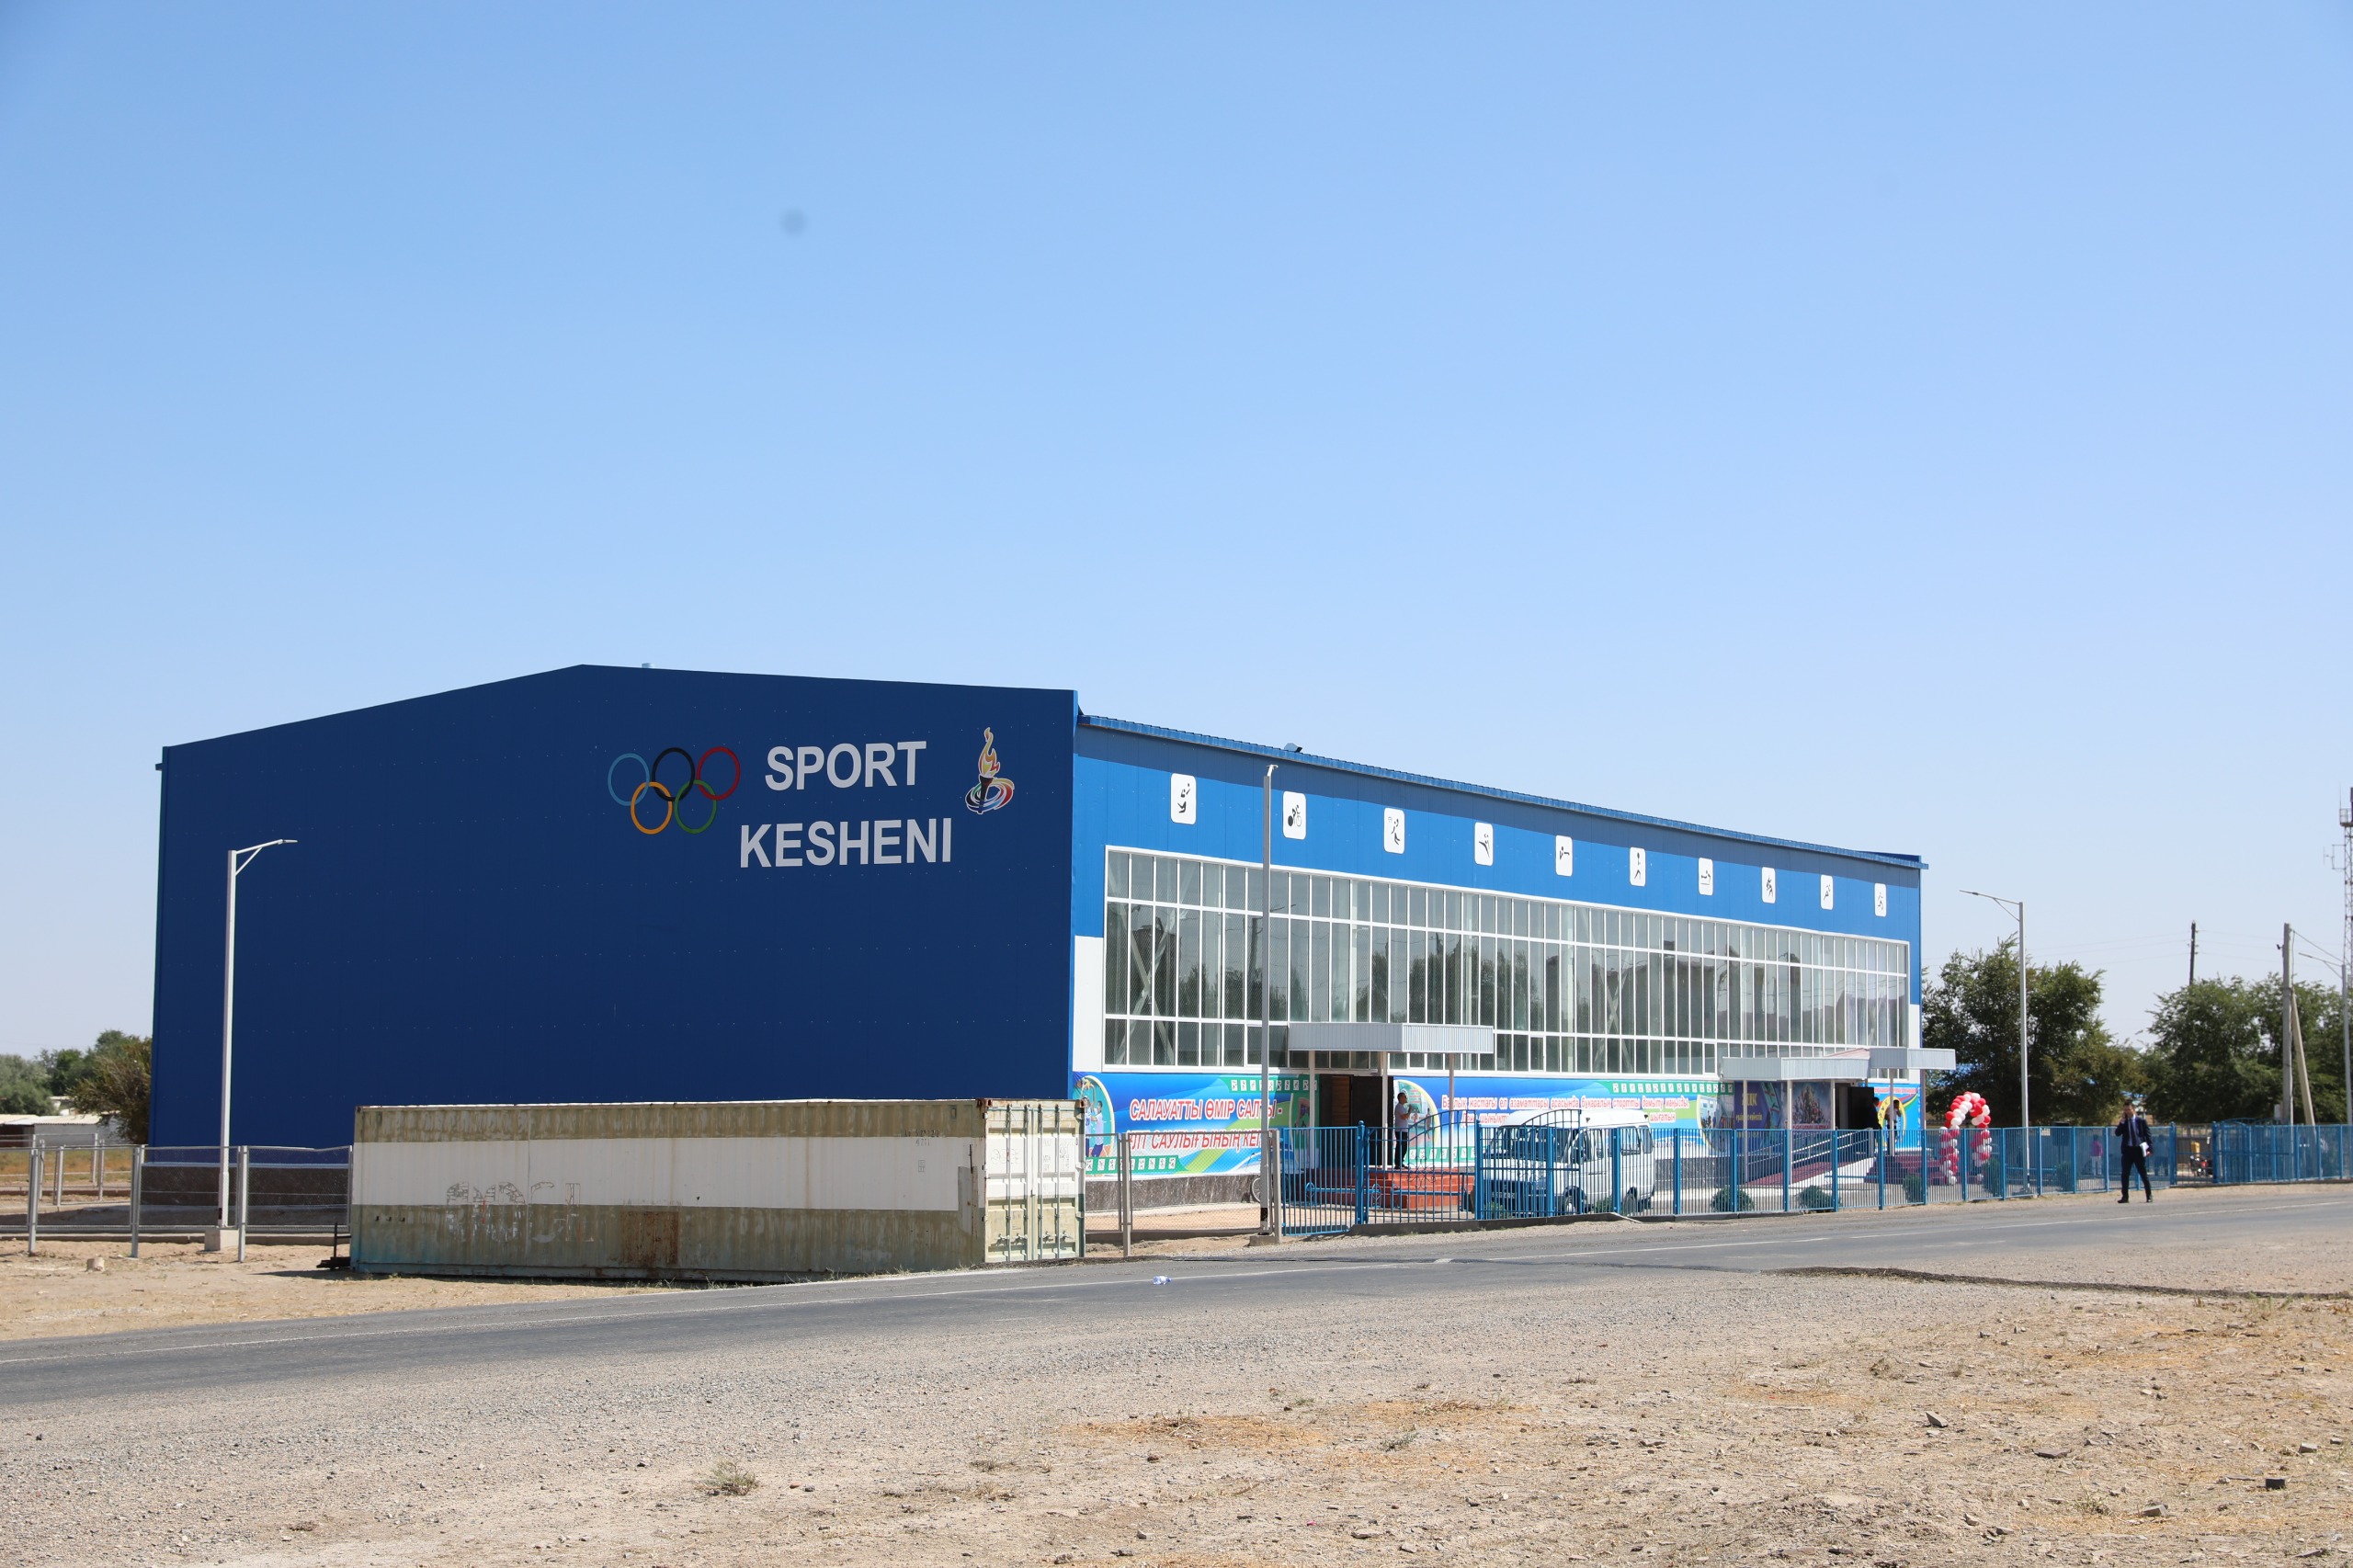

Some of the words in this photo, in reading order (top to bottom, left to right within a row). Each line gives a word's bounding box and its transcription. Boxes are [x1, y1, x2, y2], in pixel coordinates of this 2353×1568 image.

[765, 740, 927, 791] SPORT
[740, 817, 952, 869] KESHENI
[1130, 1100, 1203, 1119] САЛАУАТТЫ
[1206, 1100, 1234, 1119] ӨМІР
[1237, 1100, 1277, 1119] САЛЫ
